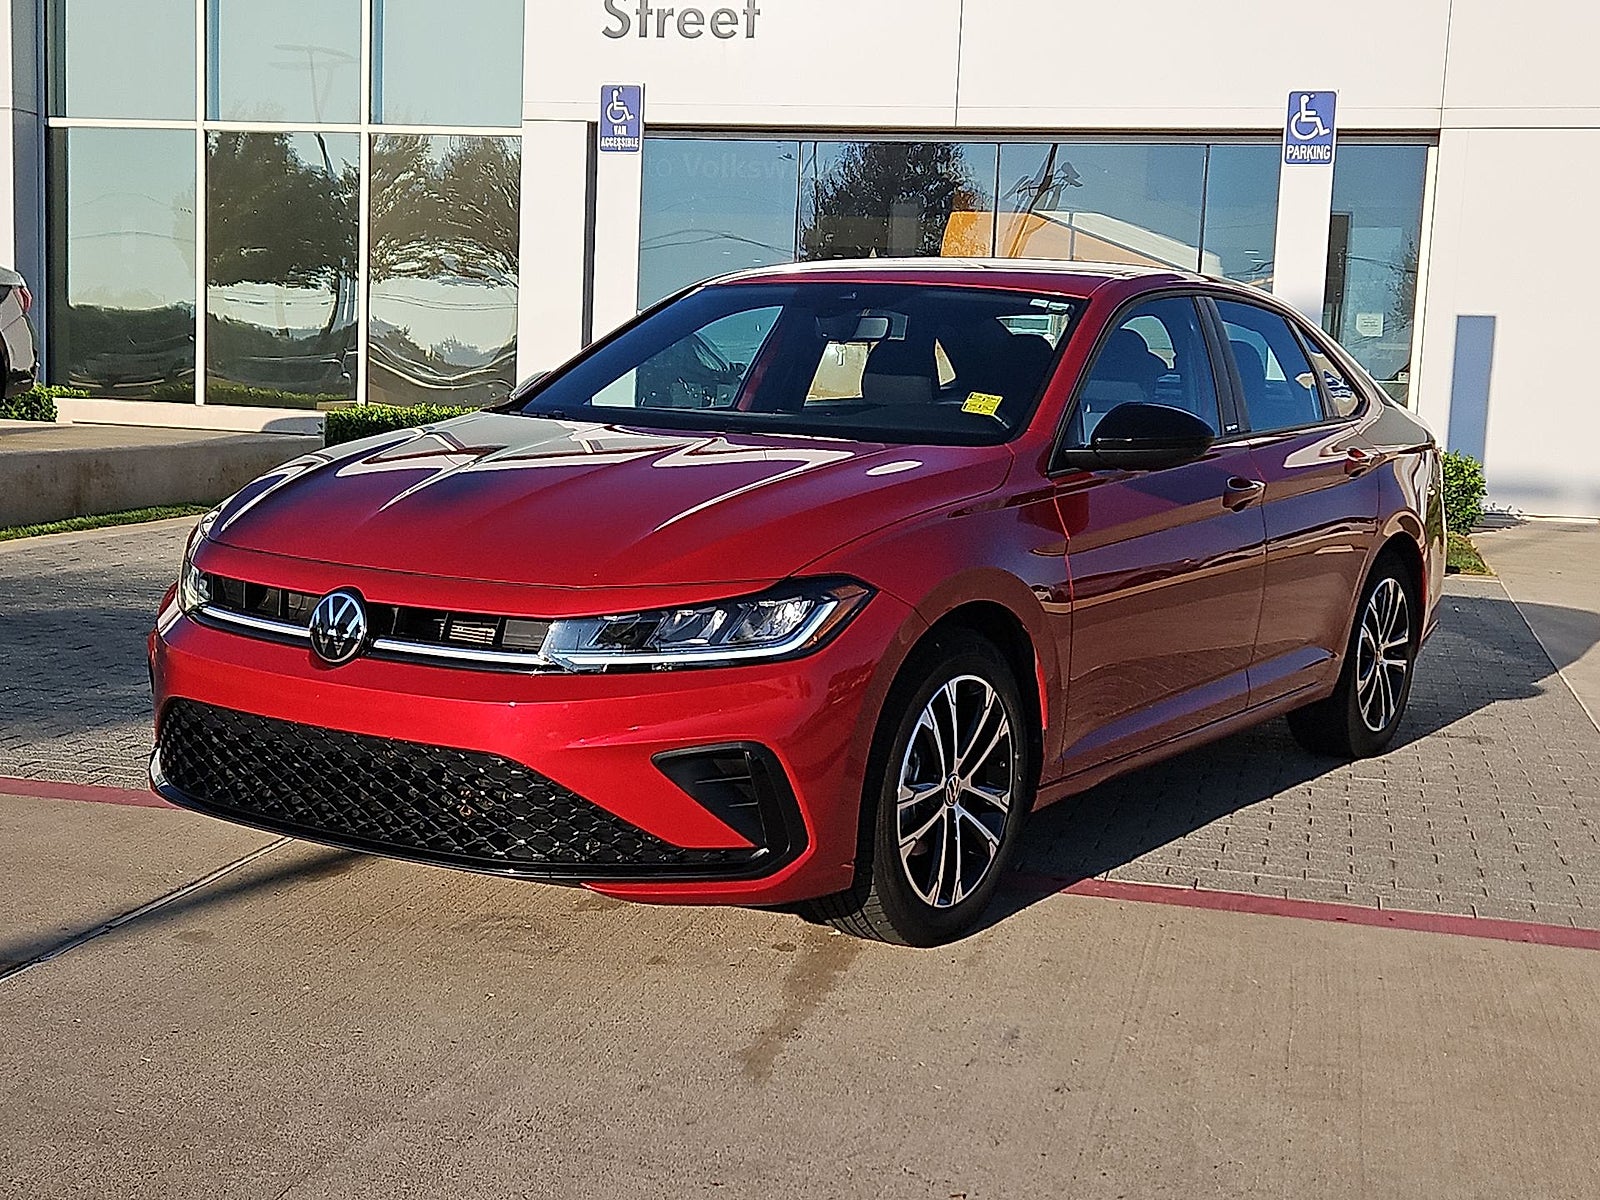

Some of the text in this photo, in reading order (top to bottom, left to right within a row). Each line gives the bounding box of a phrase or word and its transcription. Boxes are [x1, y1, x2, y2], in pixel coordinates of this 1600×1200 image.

[601, 0, 761, 39] Street
[613, 125, 627, 136] VAN
[601, 136, 639, 148] ACCESSIBLE
[1286, 144, 1331, 160] PARKING
